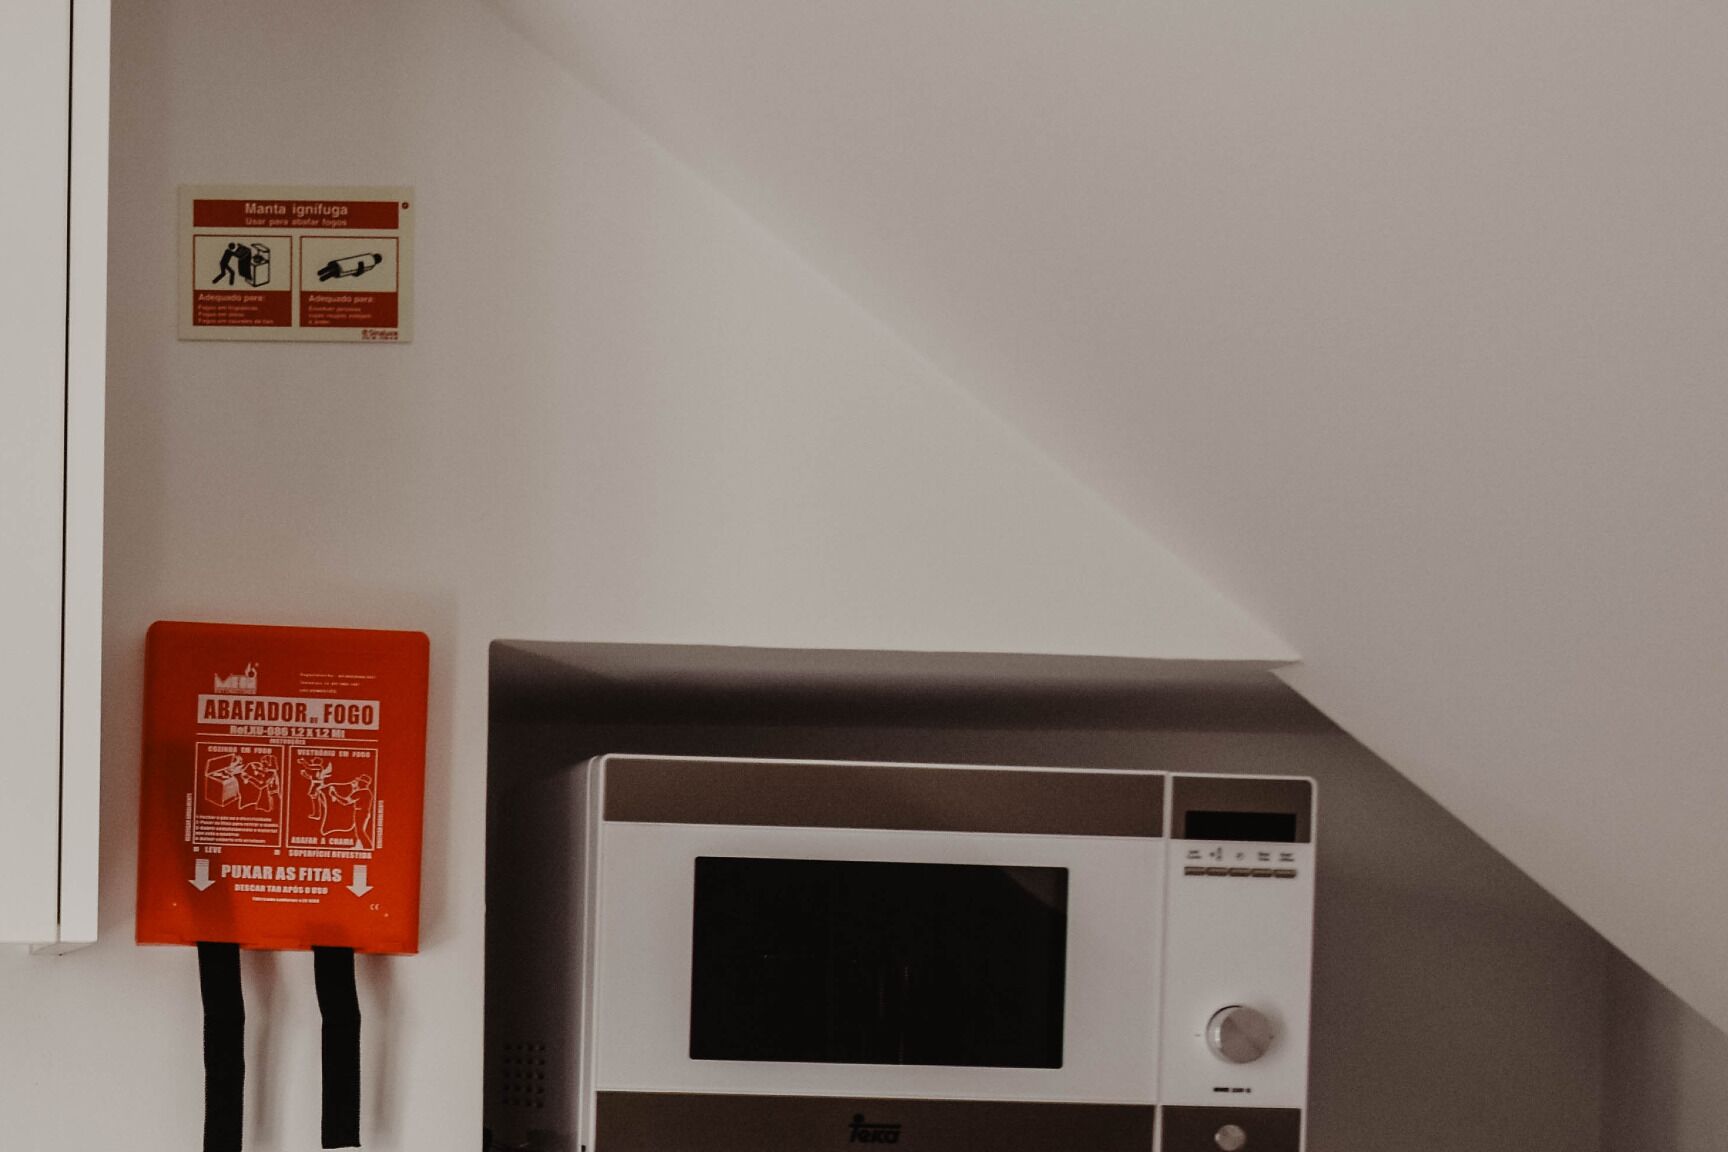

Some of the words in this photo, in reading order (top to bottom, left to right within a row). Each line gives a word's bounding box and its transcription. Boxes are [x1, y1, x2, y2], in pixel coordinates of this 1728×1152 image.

[245, 202, 286, 215] Manta
[204, 699, 308, 723] ABAFADOR
[323, 703, 374, 726] FOGO
[221, 864, 273, 880] PUXAR
[275, 866, 296, 881] AS
[299, 867, 342, 882] FITAS
